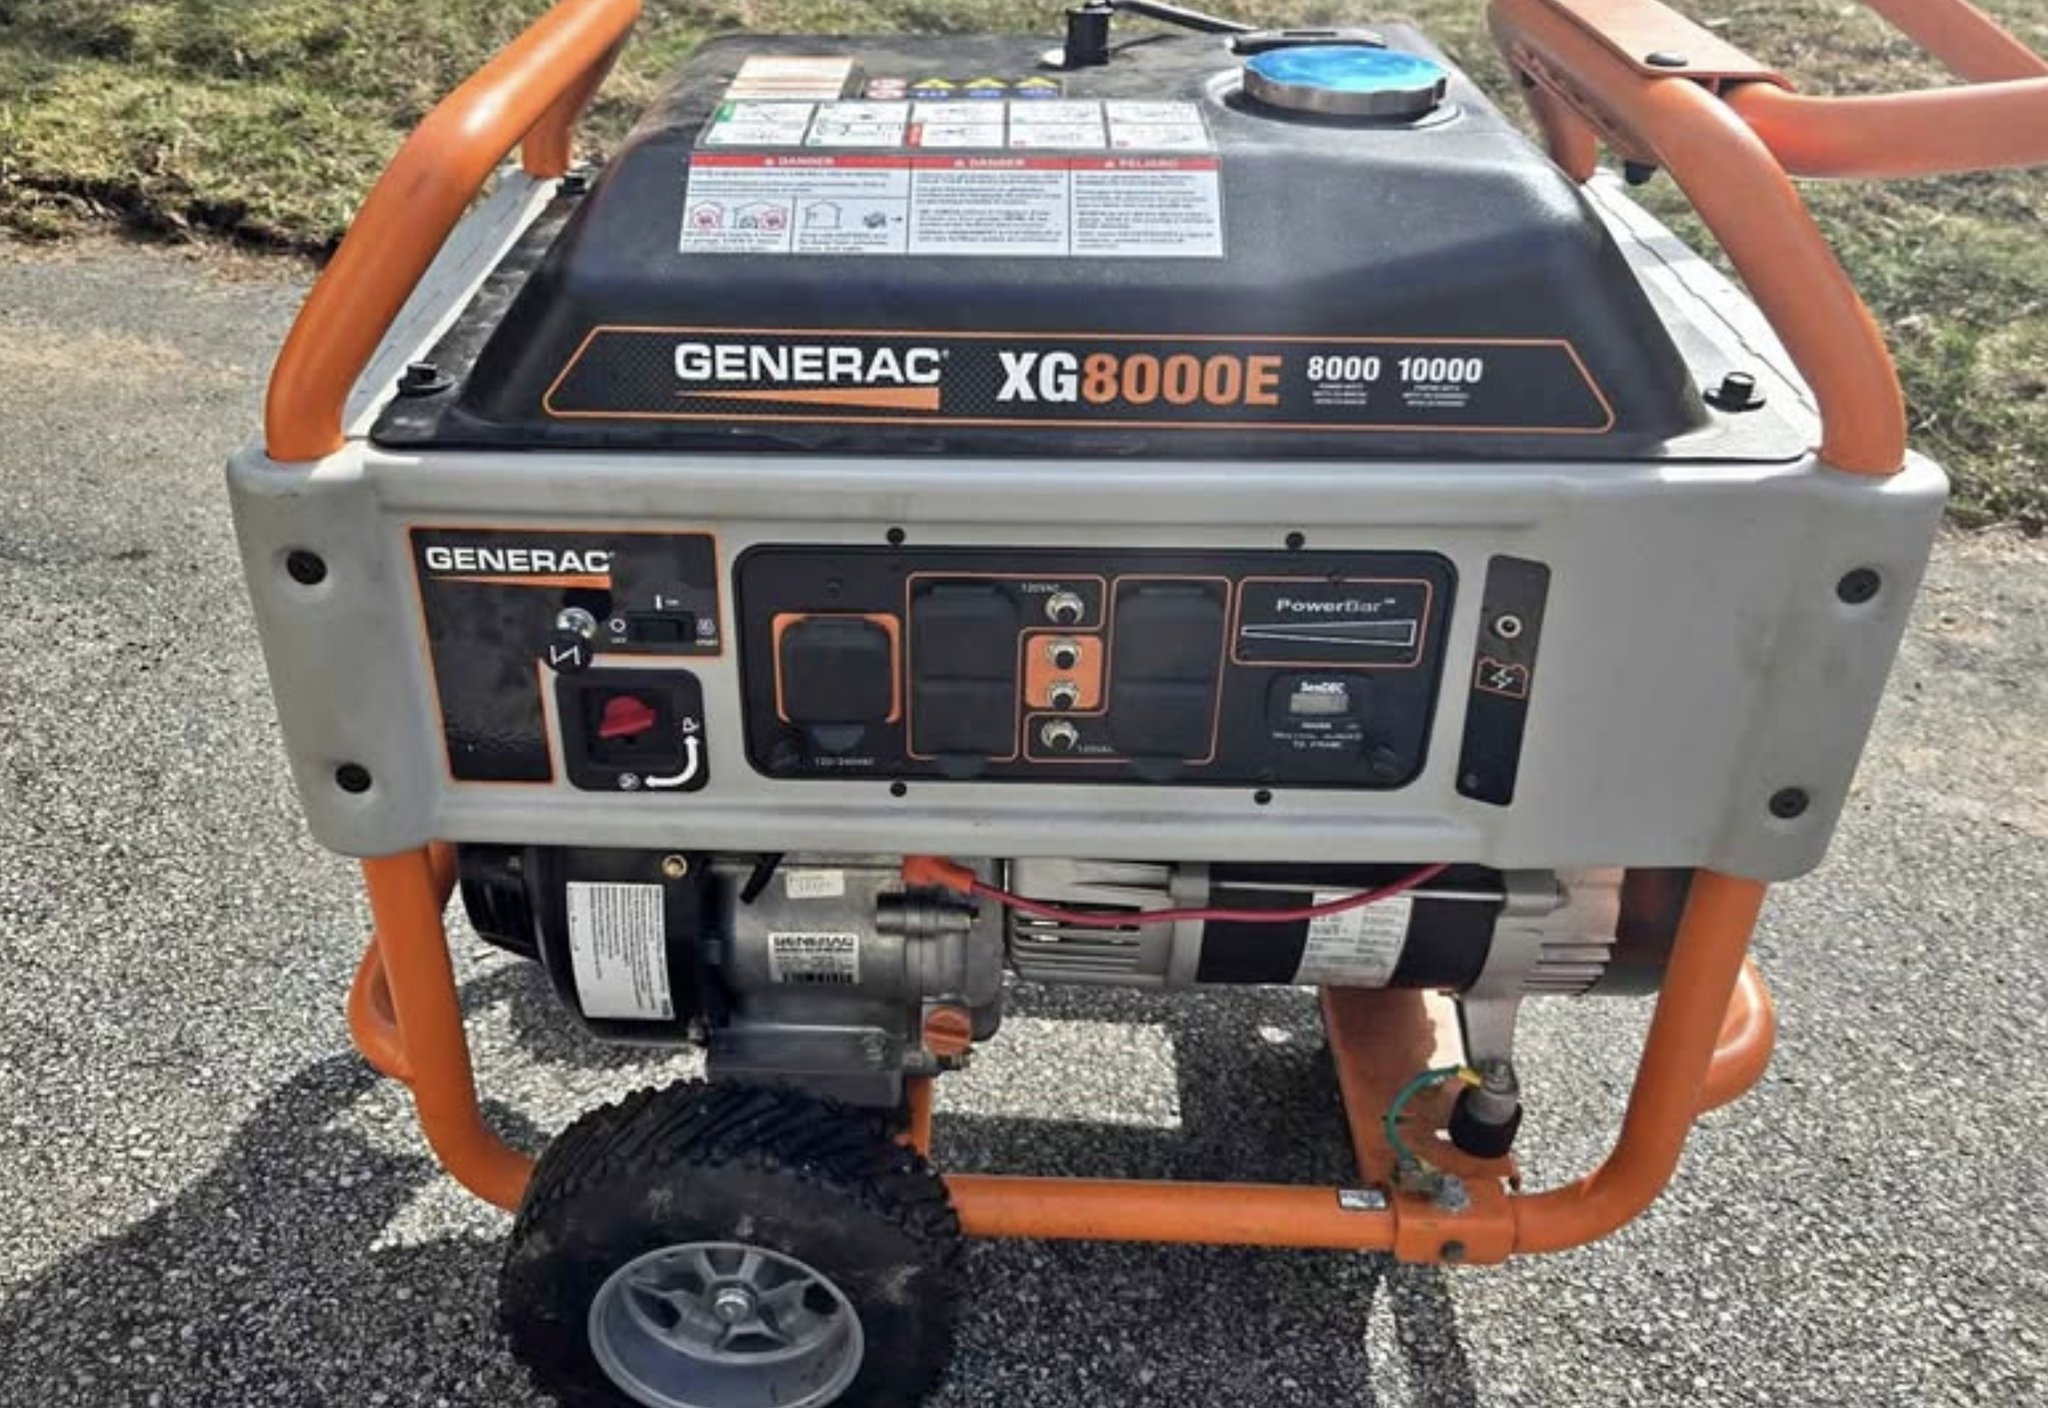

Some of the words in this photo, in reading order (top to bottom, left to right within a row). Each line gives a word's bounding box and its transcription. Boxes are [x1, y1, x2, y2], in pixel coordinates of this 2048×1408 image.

[674, 343, 942, 384] GENERAC
[997, 351, 1283, 406] XG8000E
[1307, 355, 1381, 381] 8000
[1397, 357, 1484, 383] 10000
[425, 546, 611, 573] GENERAC
